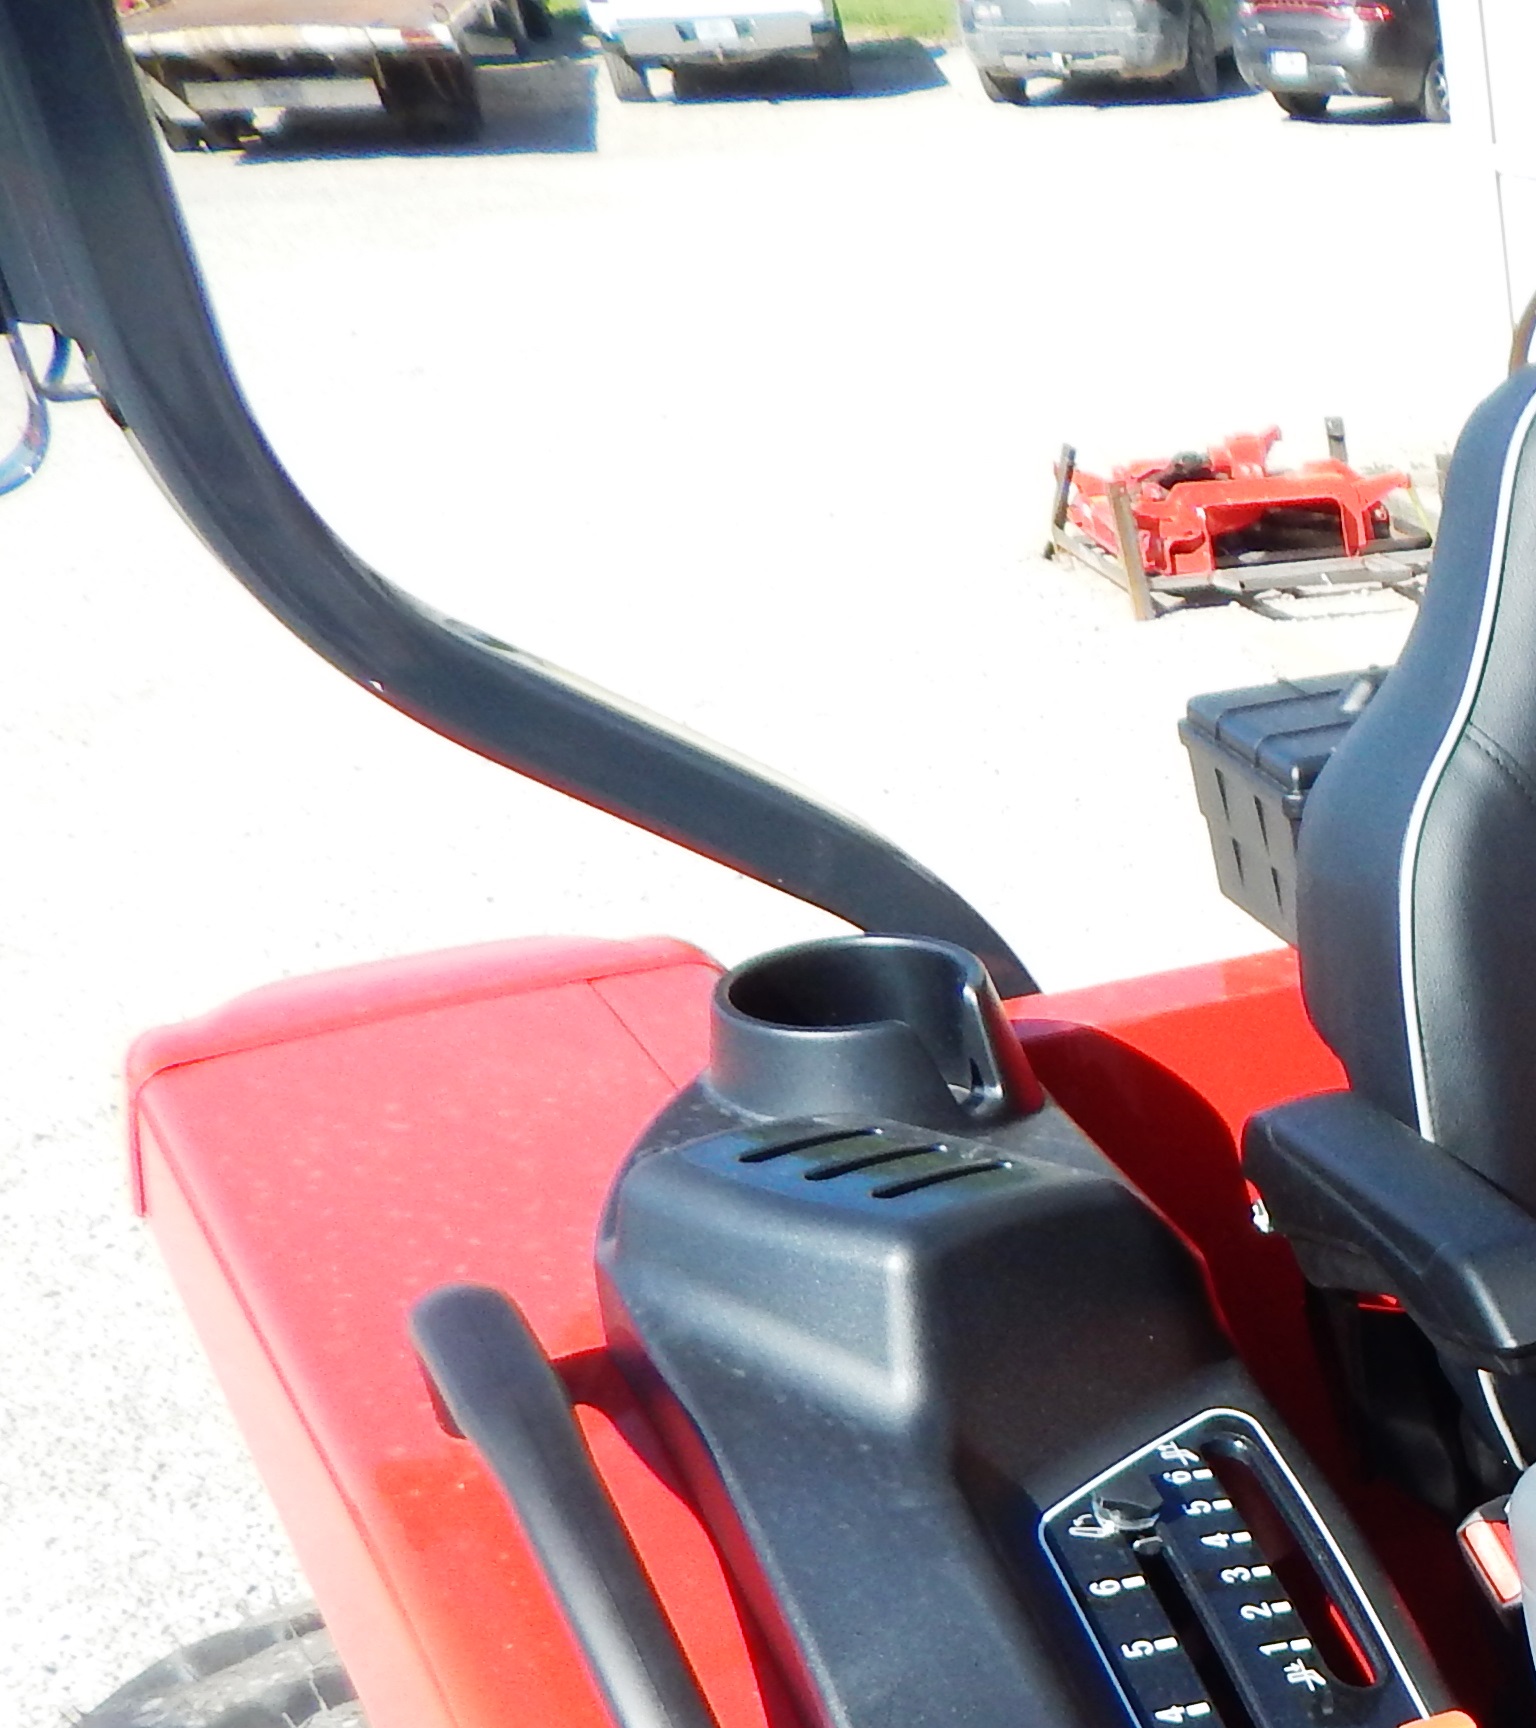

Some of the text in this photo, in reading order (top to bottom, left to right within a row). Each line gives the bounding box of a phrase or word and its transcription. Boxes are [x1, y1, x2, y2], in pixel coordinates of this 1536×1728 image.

[1163, 1469, 1192, 1486] 6
[1181, 1500, 1212, 1515] 5
[1200, 1532, 1230, 1548] 4
[1220, 1566, 1251, 1584] 3
[1088, 1578, 1121, 1597] 6
[1240, 1602, 1273, 1620] 2
[1121, 1640, 1154, 1659] 5
[1258, 1642, 1289, 1656] 1
[1154, 1705, 1186, 1724] 4
